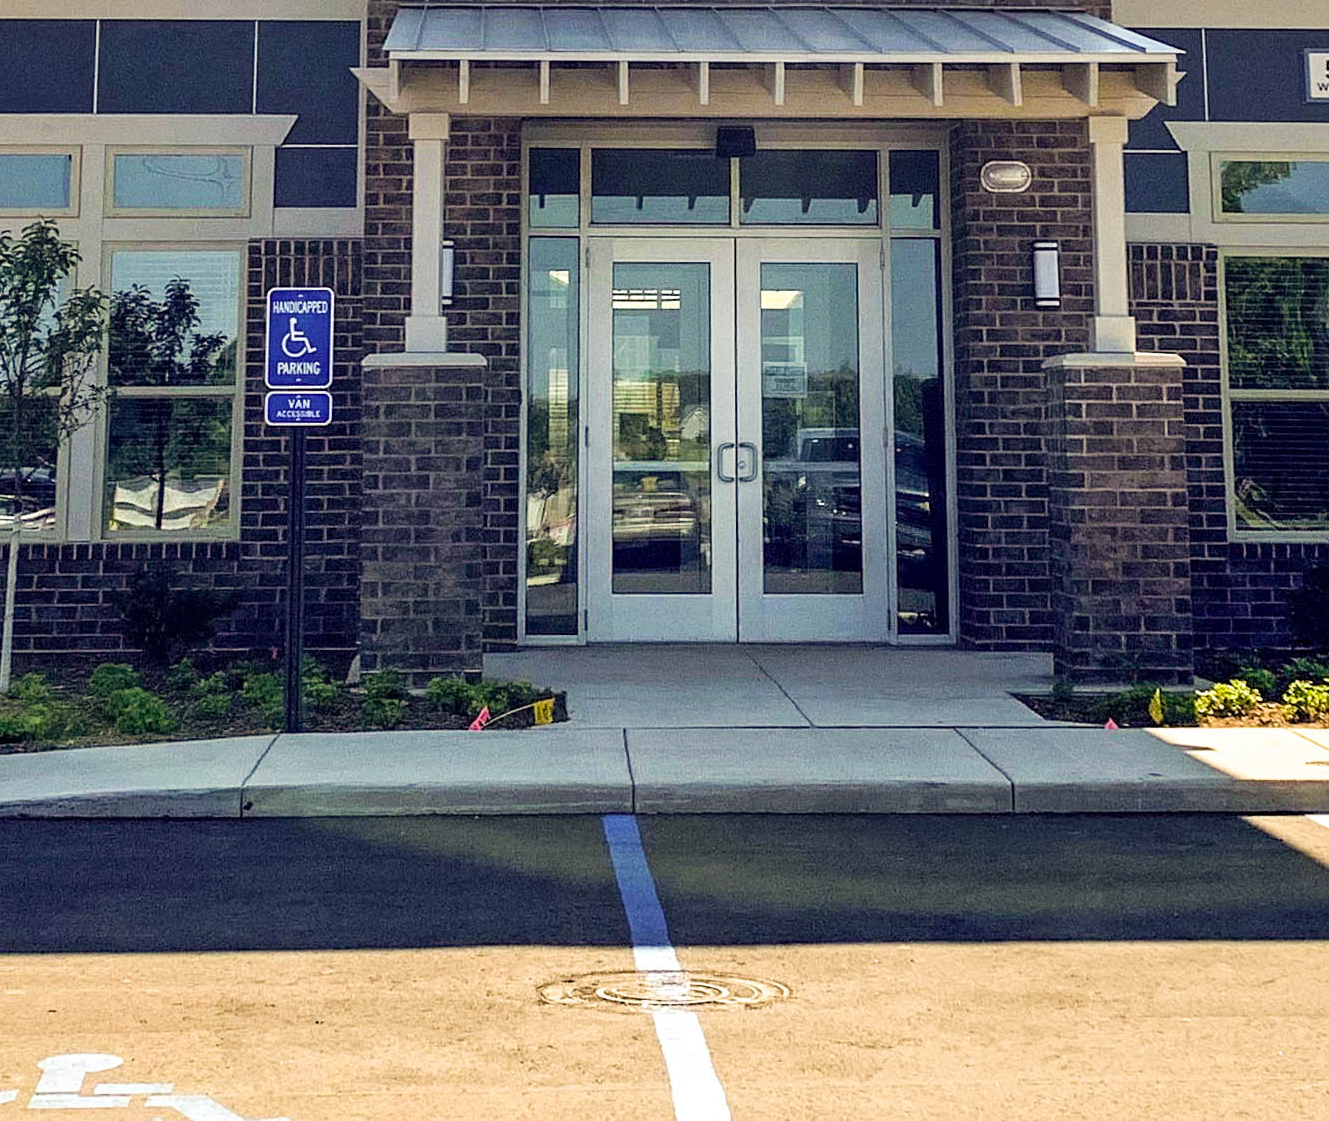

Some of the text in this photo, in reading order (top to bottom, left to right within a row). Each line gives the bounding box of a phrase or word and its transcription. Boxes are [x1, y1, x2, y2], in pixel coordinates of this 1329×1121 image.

[272, 300, 329, 314] HANDICAPPED
[277, 361, 321, 376] PARKING
[287, 398, 311, 409] VAN
[276, 410, 321, 419] ACCESSIBLE
